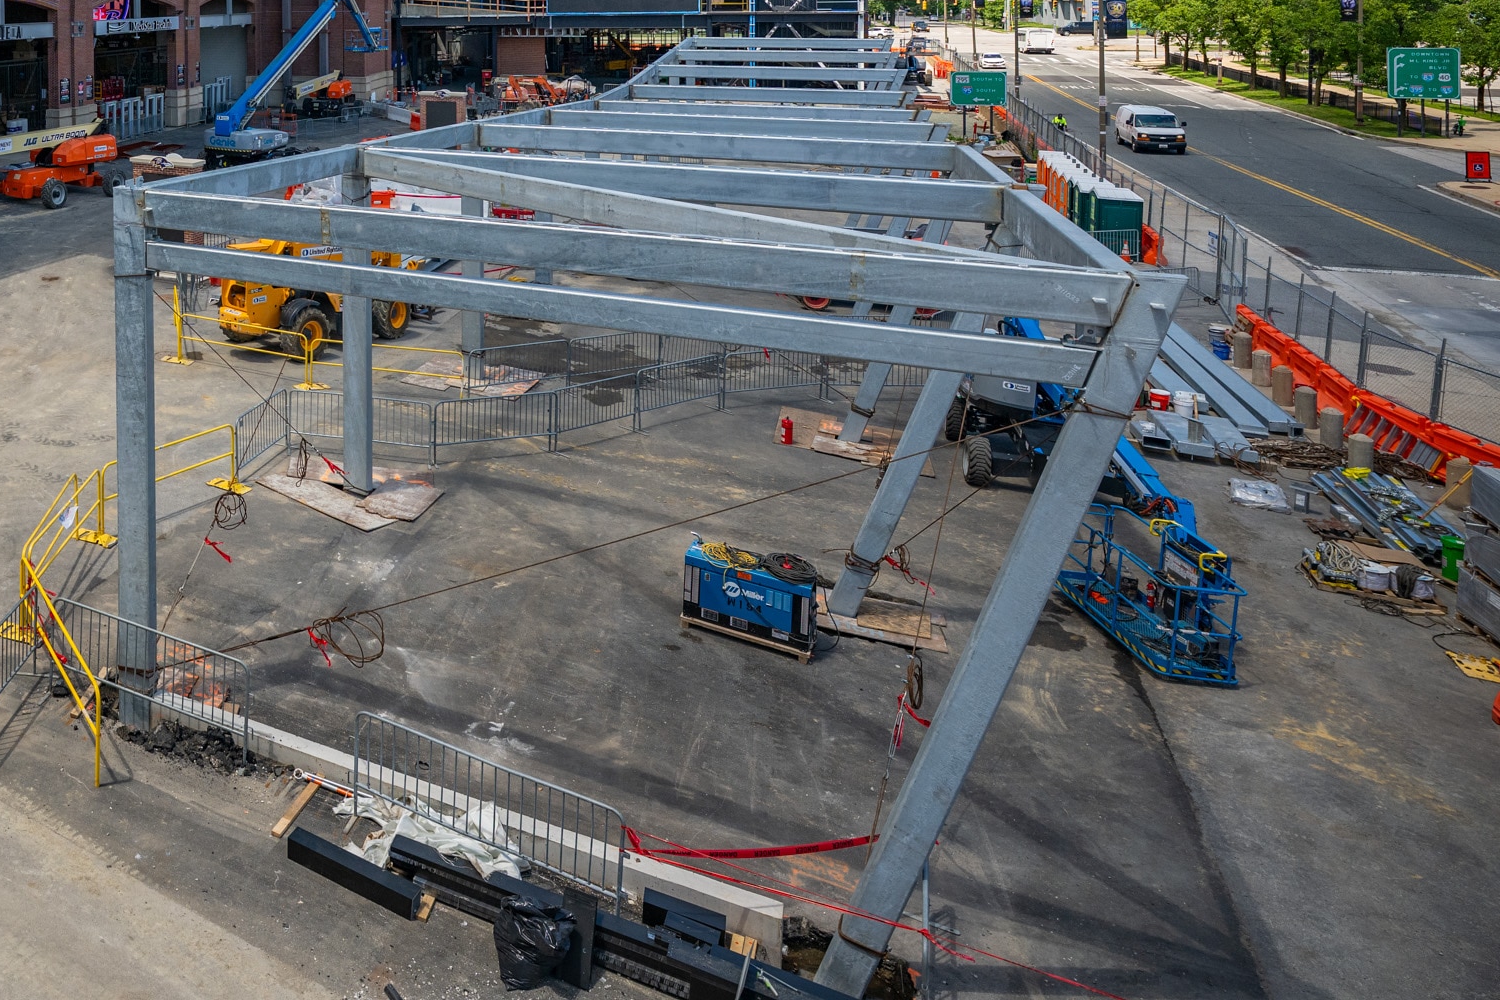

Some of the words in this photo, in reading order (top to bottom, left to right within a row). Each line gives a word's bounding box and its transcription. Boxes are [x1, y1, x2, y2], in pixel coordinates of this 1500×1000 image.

[16, 26, 22, 39] A
[23, 137, 38, 147] JLG
[41, 133, 64, 143] ULTRA
[65, 129, 86, 139] BOOM
[209, 136, 236, 147] Genie
[741, 588, 765, 602] Miller
[754, 849, 781, 857] DANGER
[795, 845, 820, 854] DANGER
[831, 840, 854, 850] DANGER
